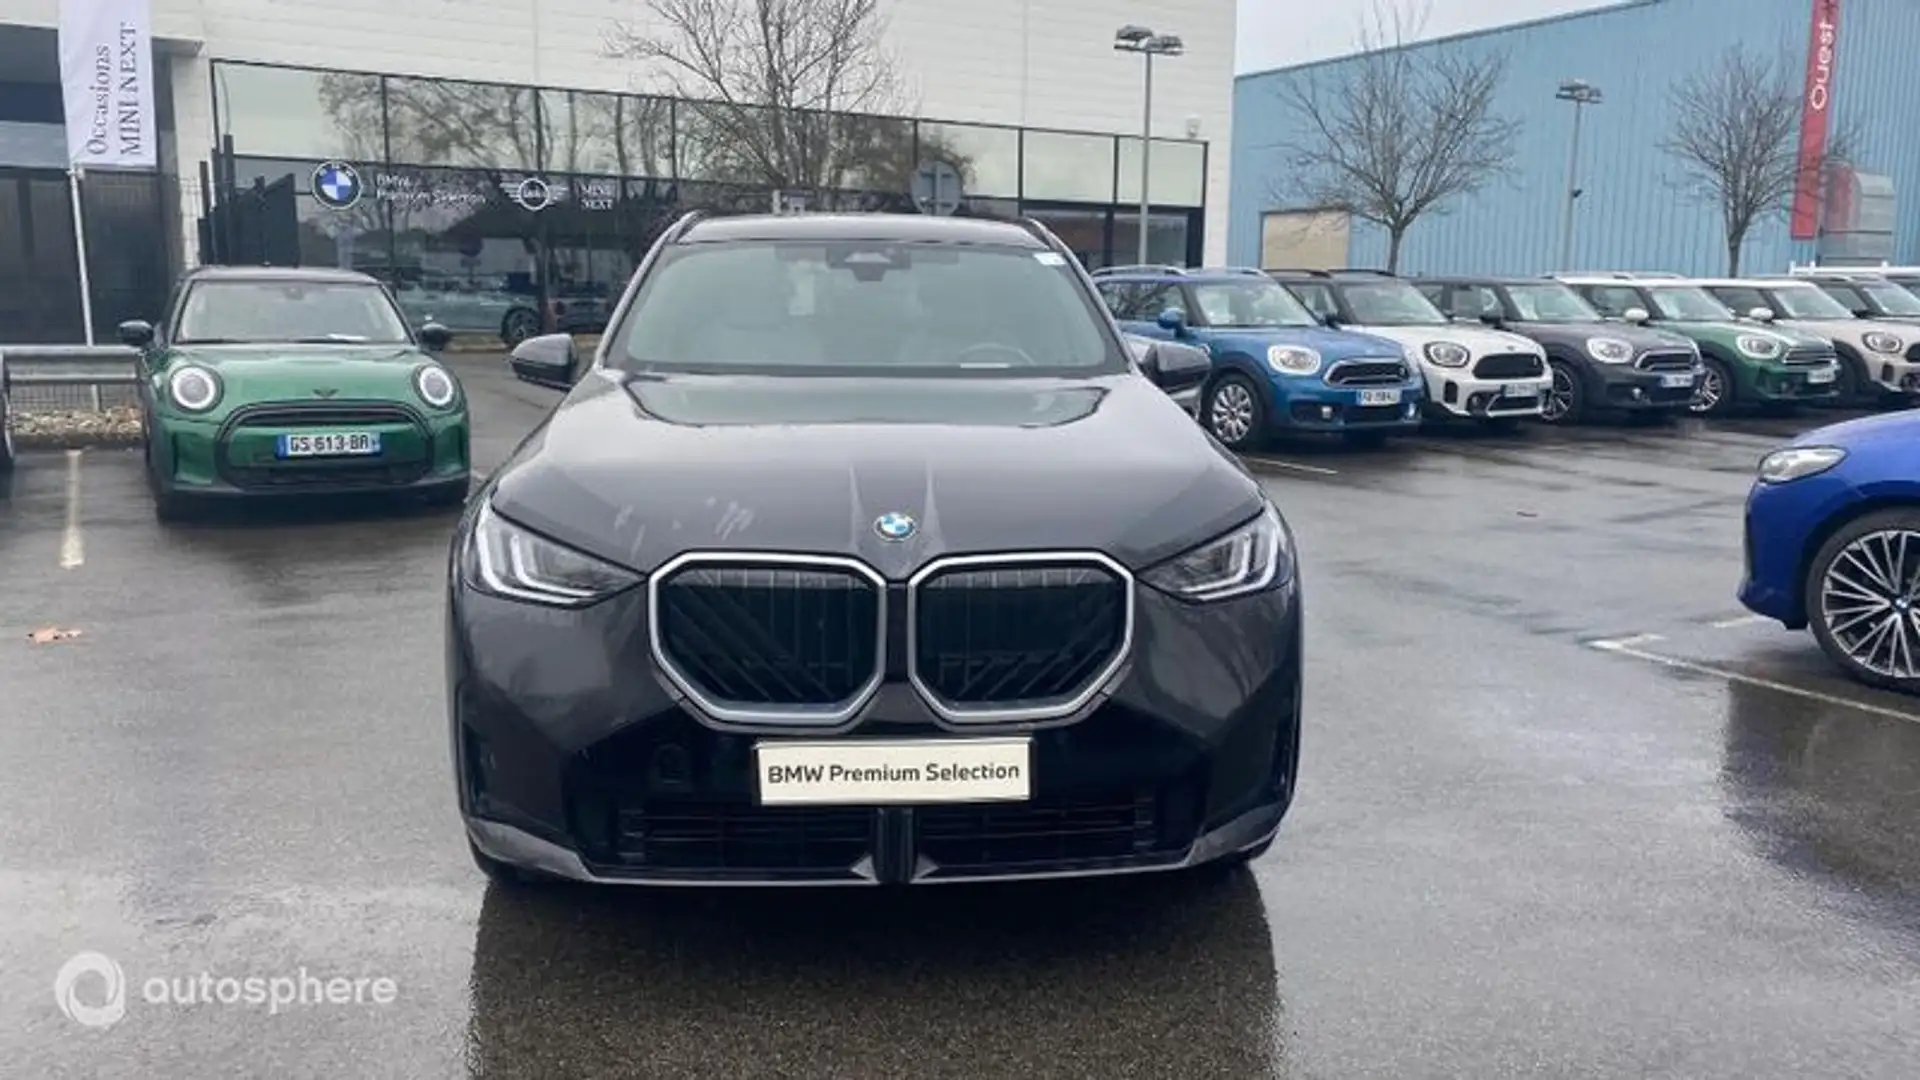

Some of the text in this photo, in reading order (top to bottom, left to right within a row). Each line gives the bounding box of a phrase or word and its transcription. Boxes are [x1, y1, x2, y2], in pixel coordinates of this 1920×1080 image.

[86, 44, 110, 155] Occasions
[118, 21, 142, 155] MINI NEXT
[1810, 18, 1835, 110] Ouest
[767, 762, 1021, 784] BMW Premium Selection
